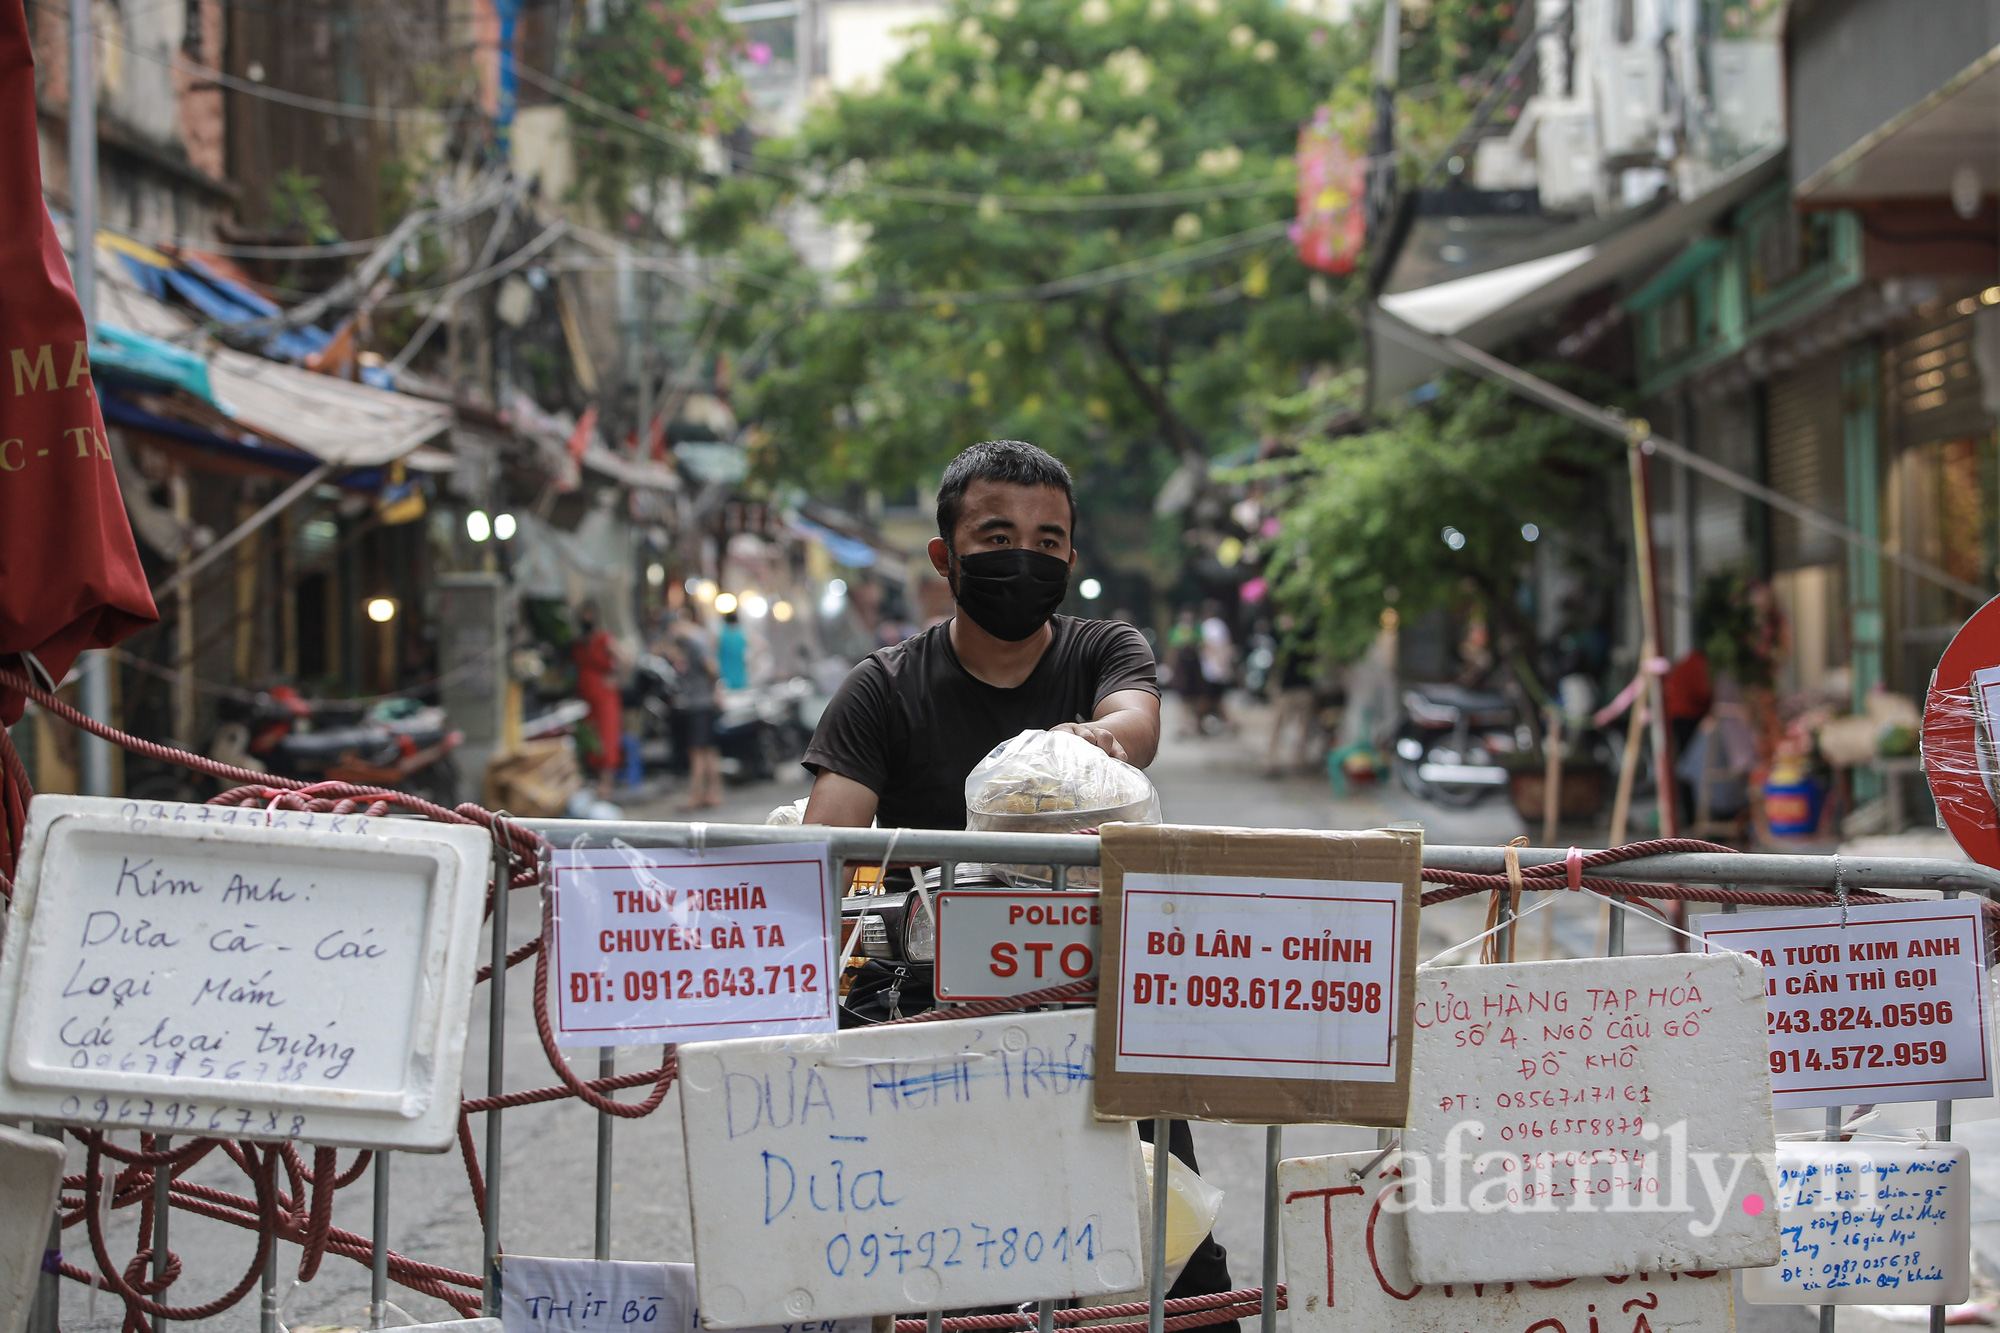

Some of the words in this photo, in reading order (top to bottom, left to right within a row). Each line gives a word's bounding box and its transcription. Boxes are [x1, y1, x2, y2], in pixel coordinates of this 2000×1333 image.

[116, 857, 203, 897] Kim
[687, 882, 767, 912] NGHĨA
[1009, 905, 1101, 925] POLICE
[314, 928, 387, 960] Các
[600, 923, 701, 953] CHUYÊN
[711, 921, 745, 949] GÀ
[753, 924, 785, 948] TA
[1147, 926, 1185, 955] BÒ
[1196, 929, 1251, 959] LÂN
[1282, 930, 1372, 964] CHỈNH
[1783, 944, 1840, 965] TƯƠI
[1850, 941, 1898, 962] KIM
[1907, 937, 1960, 958] ANH
[62, 959, 155, 1009] Loại
[570, 972, 613, 1003] ĐT:
[624, 963, 817, 1001] 0912.643.712
[1133, 973, 1177, 1006] ĐT:
[1187, 976, 1381, 1014] 093.612.9598
[1785, 970, 1838, 995] CẦN
[1846, 967, 1886, 991] THÌ
[1895, 968, 1937, 991] GỌI
[1483, 984, 1568, 1017] HÀNG
[1587, 988, 1637, 1015] TẠP
[60, 1016, 114, 1046] Các
[1543, 1016, 1593, 1042] NGÕ
[1664, 1007, 1712, 1037] GỖ
[1586, 1044, 1638, 1070] KHÔ
[1497, 1085, 1651, 1108] 0856717161
[61, 1095, 306, 1136] 0967956788
[1501, 1116, 1643, 1141] 0966558879
[1777, 1164, 1819, 1189] guyệt
[827, 1221, 1098, 1277] 0979278011
[1794, 1240, 1819, 1260] Long
[622, 1297, 664, 1324] BÒ
